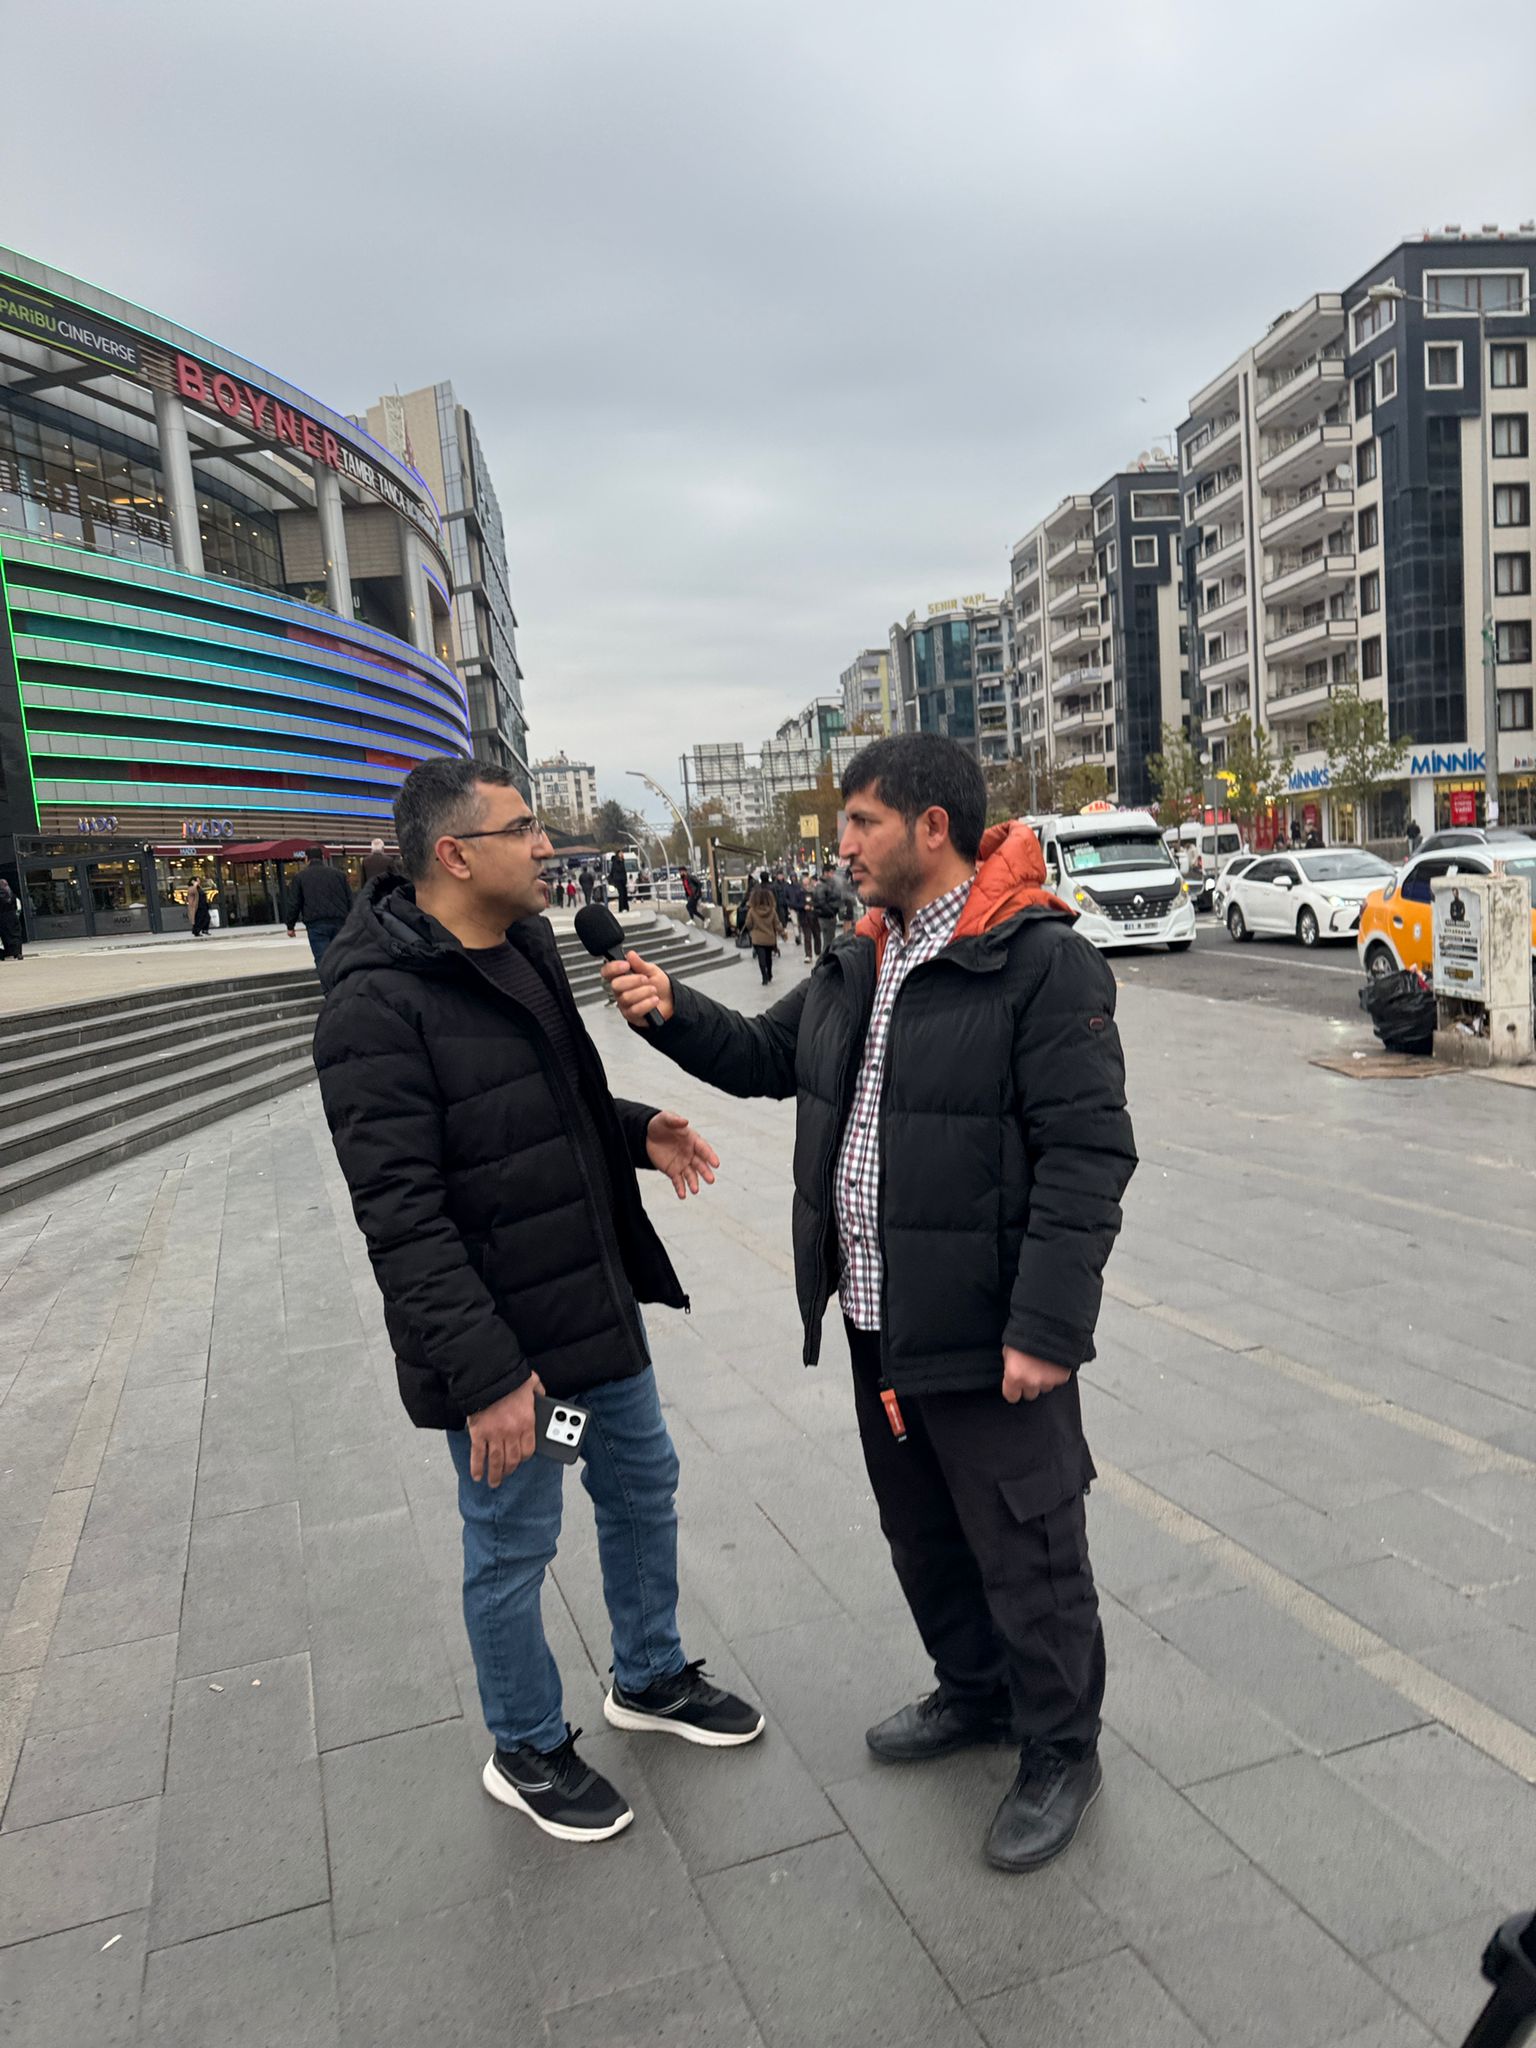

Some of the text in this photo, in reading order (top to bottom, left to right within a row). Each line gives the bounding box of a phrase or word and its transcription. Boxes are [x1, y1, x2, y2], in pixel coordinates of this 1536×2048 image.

[57, 320, 136, 364] CINEVERSE
[176, 354, 340, 470] BOYNER
[341, 447, 376, 488] TAMER
[1411, 747, 1486, 775] MİNNİK
[78, 816, 118, 833] MADO
[182, 818, 234, 838] MADO
